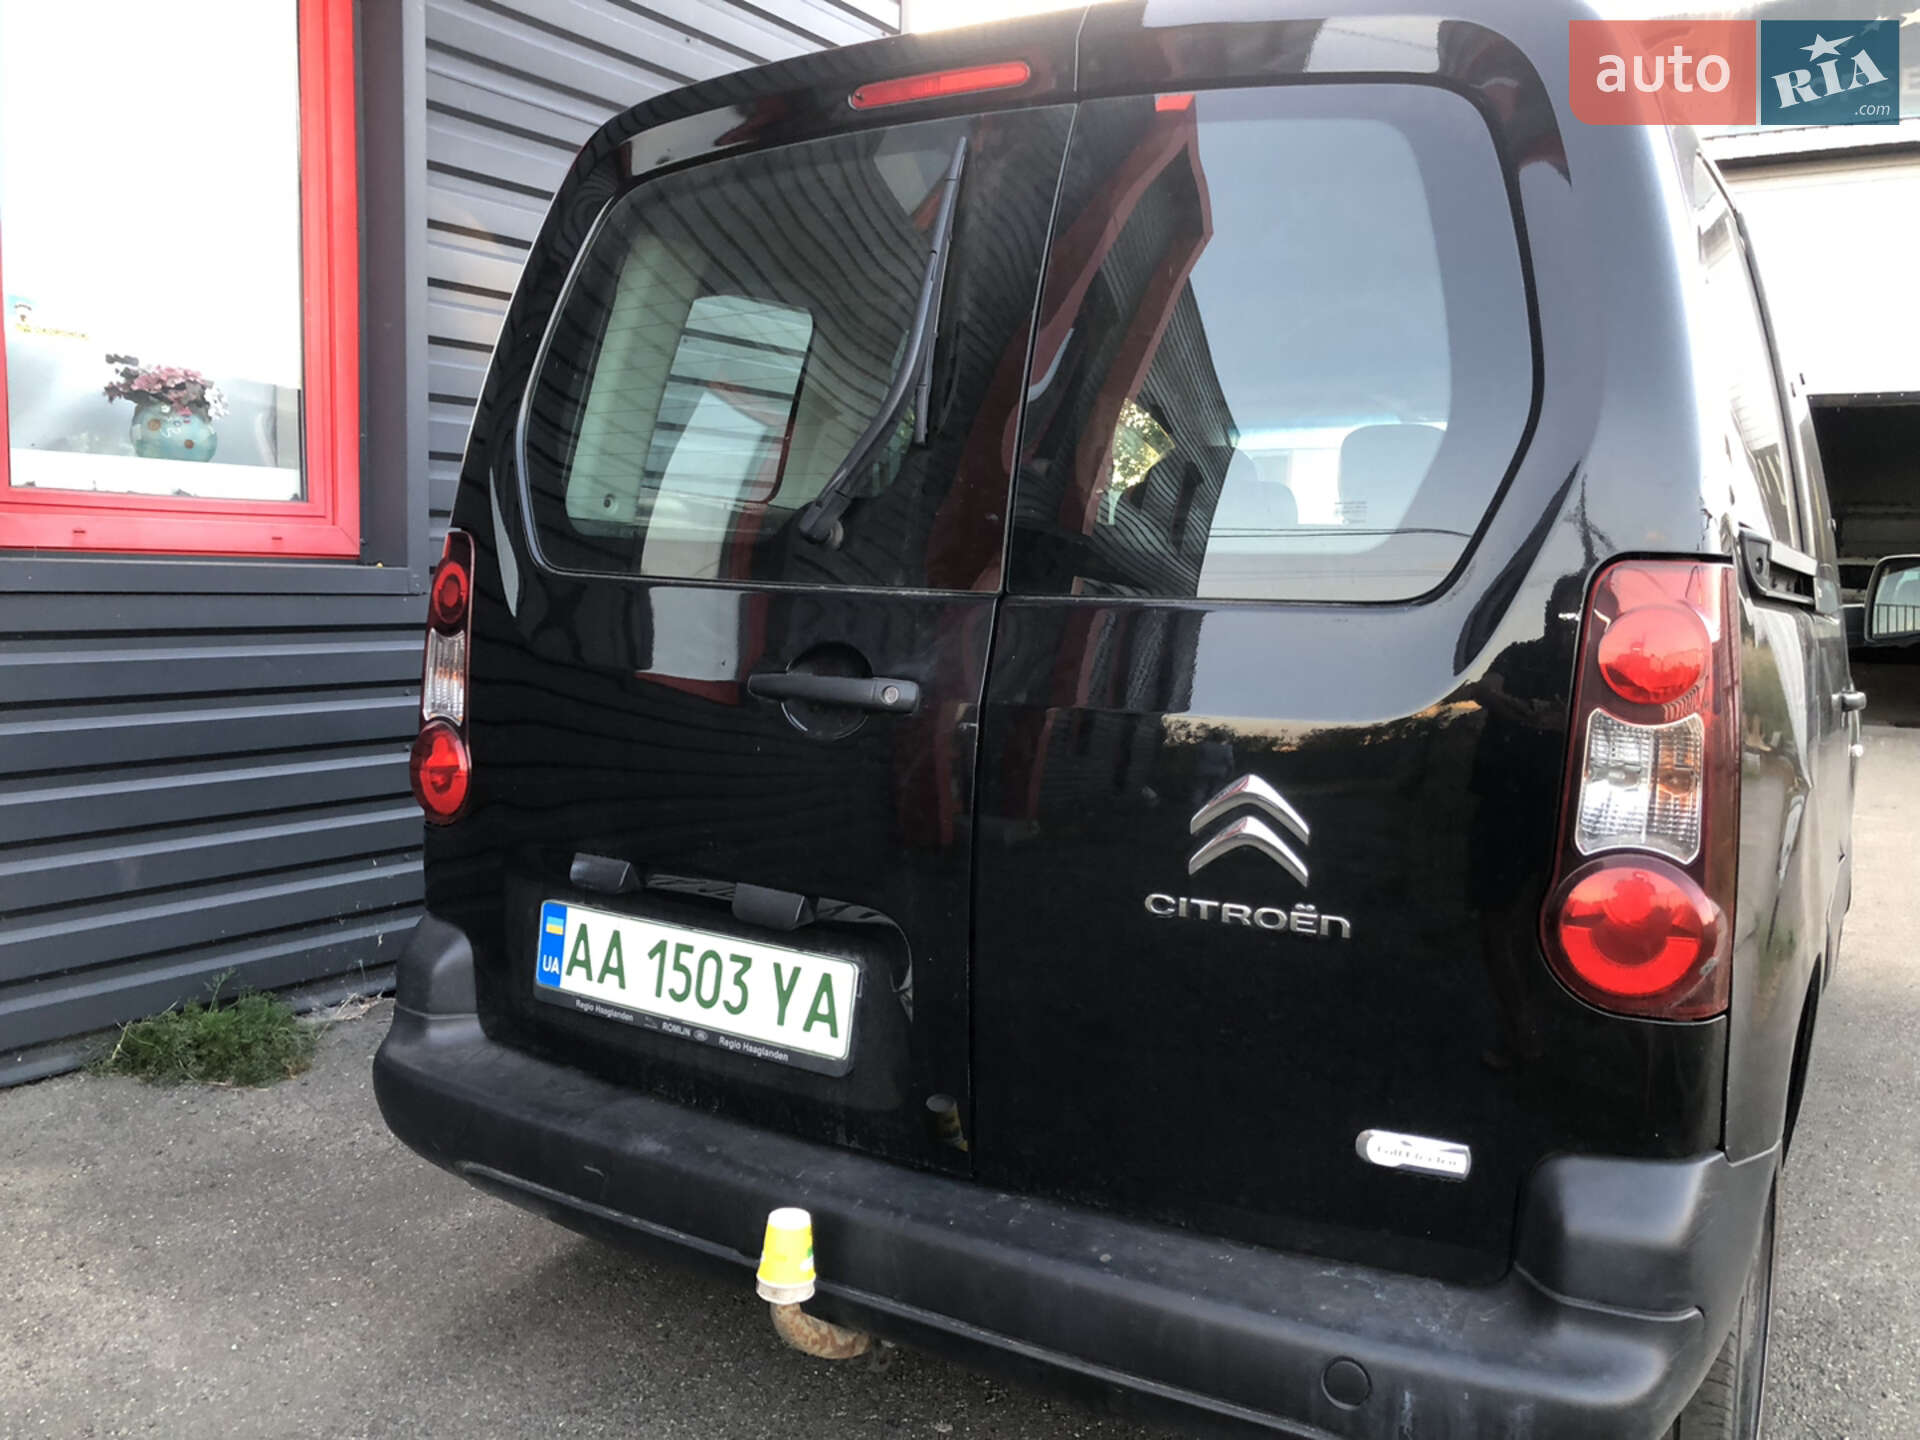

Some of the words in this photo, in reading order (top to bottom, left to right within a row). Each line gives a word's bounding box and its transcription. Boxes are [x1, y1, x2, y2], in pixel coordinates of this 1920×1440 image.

[542, 953, 560, 975] UA
[565, 923, 627, 990] AA
[647, 939, 752, 1015] 1503
[772, 962, 839, 1038] YA
